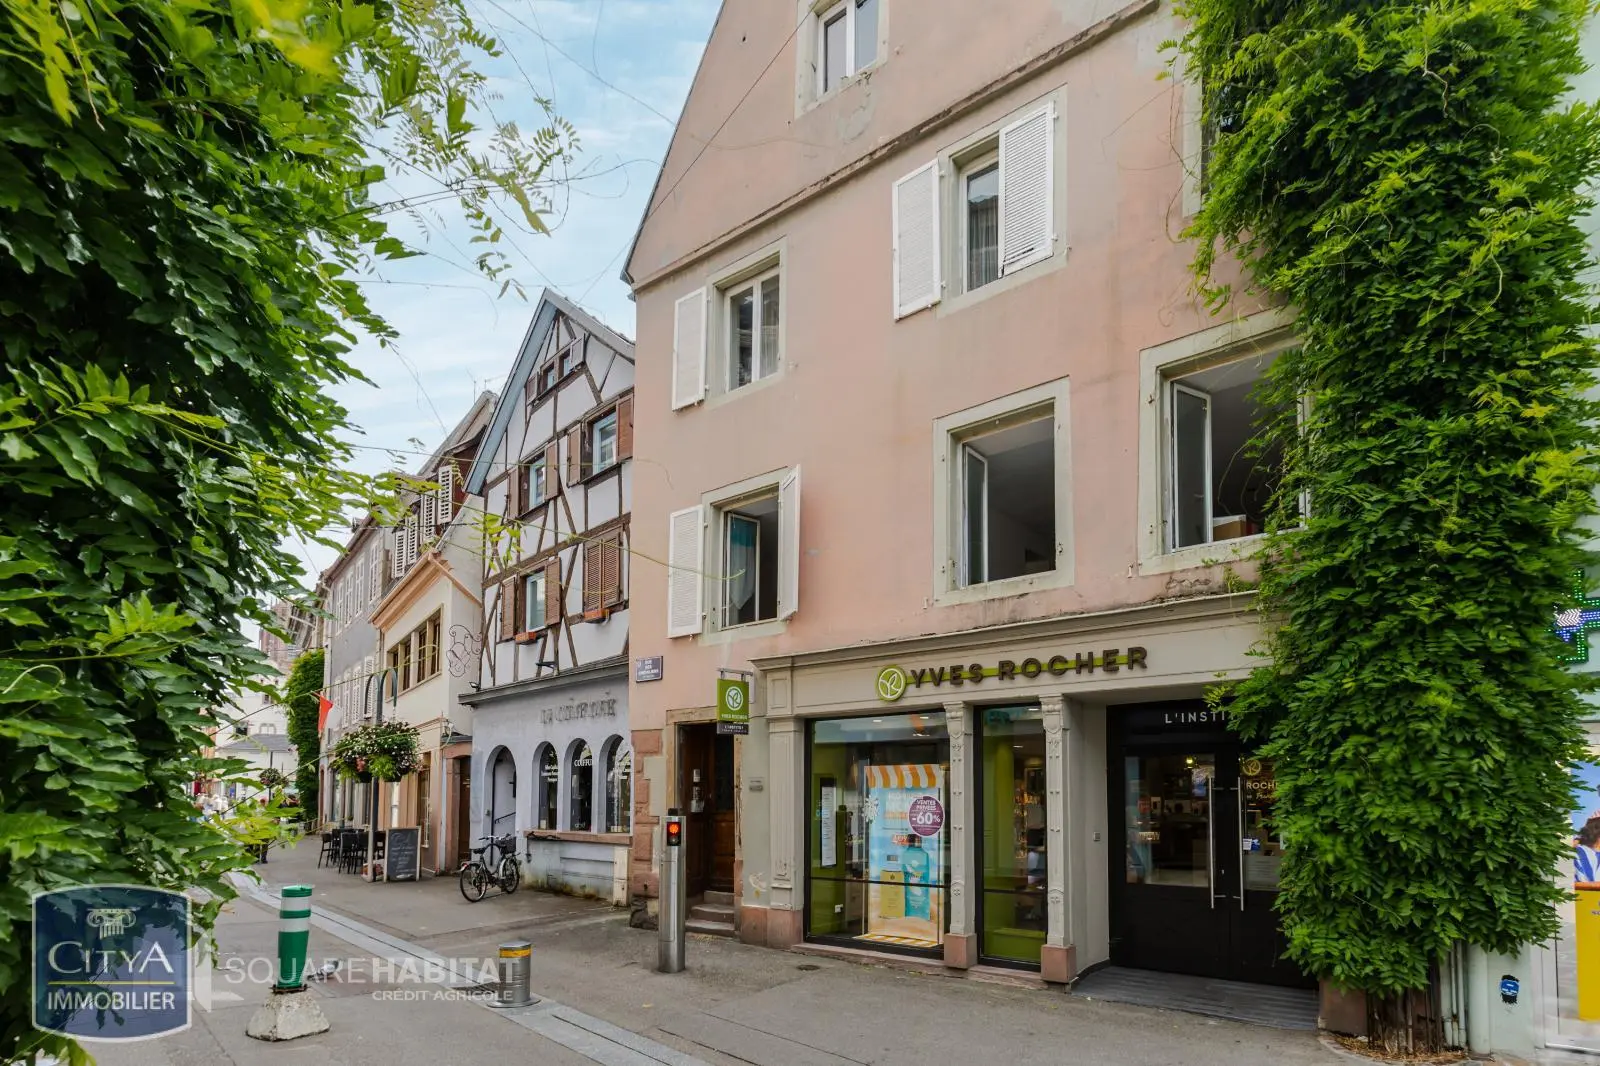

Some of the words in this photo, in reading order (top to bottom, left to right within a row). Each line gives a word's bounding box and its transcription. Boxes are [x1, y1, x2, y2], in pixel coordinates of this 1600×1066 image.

[910, 663, 984, 689] YVES
[998, 646, 1148, 681] ROCHER
[1165, 711, 1234, 724] L'INSTI
